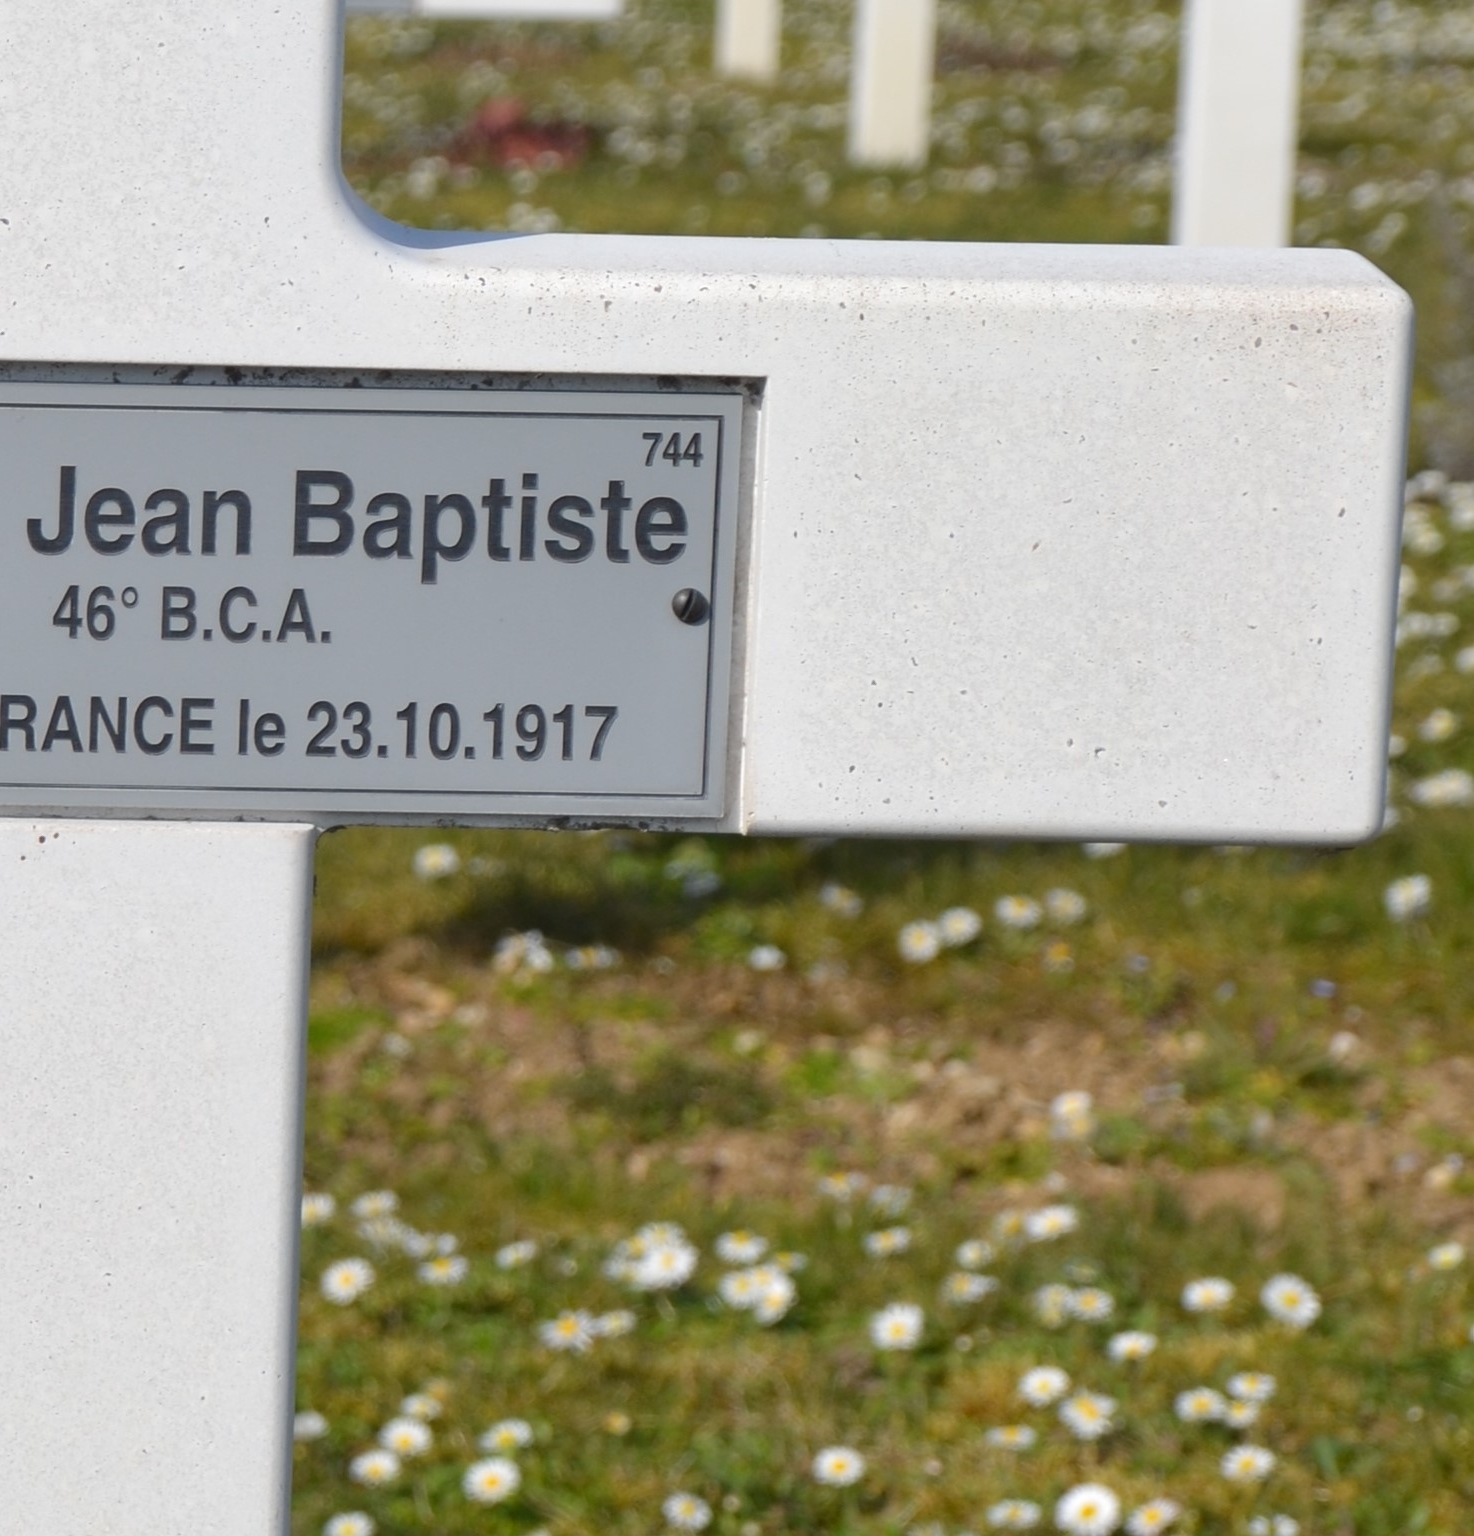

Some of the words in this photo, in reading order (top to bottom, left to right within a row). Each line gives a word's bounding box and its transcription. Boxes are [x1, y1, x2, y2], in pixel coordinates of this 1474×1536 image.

[641, 431, 704, 468] 744
[25, 465, 253, 558] Jean
[292, 469, 689, 585] Baptiste
[160, 585, 332, 644] B.C.A.
[237, 698, 287, 759] le
[304, 700, 619, 763] 23.10.1917
